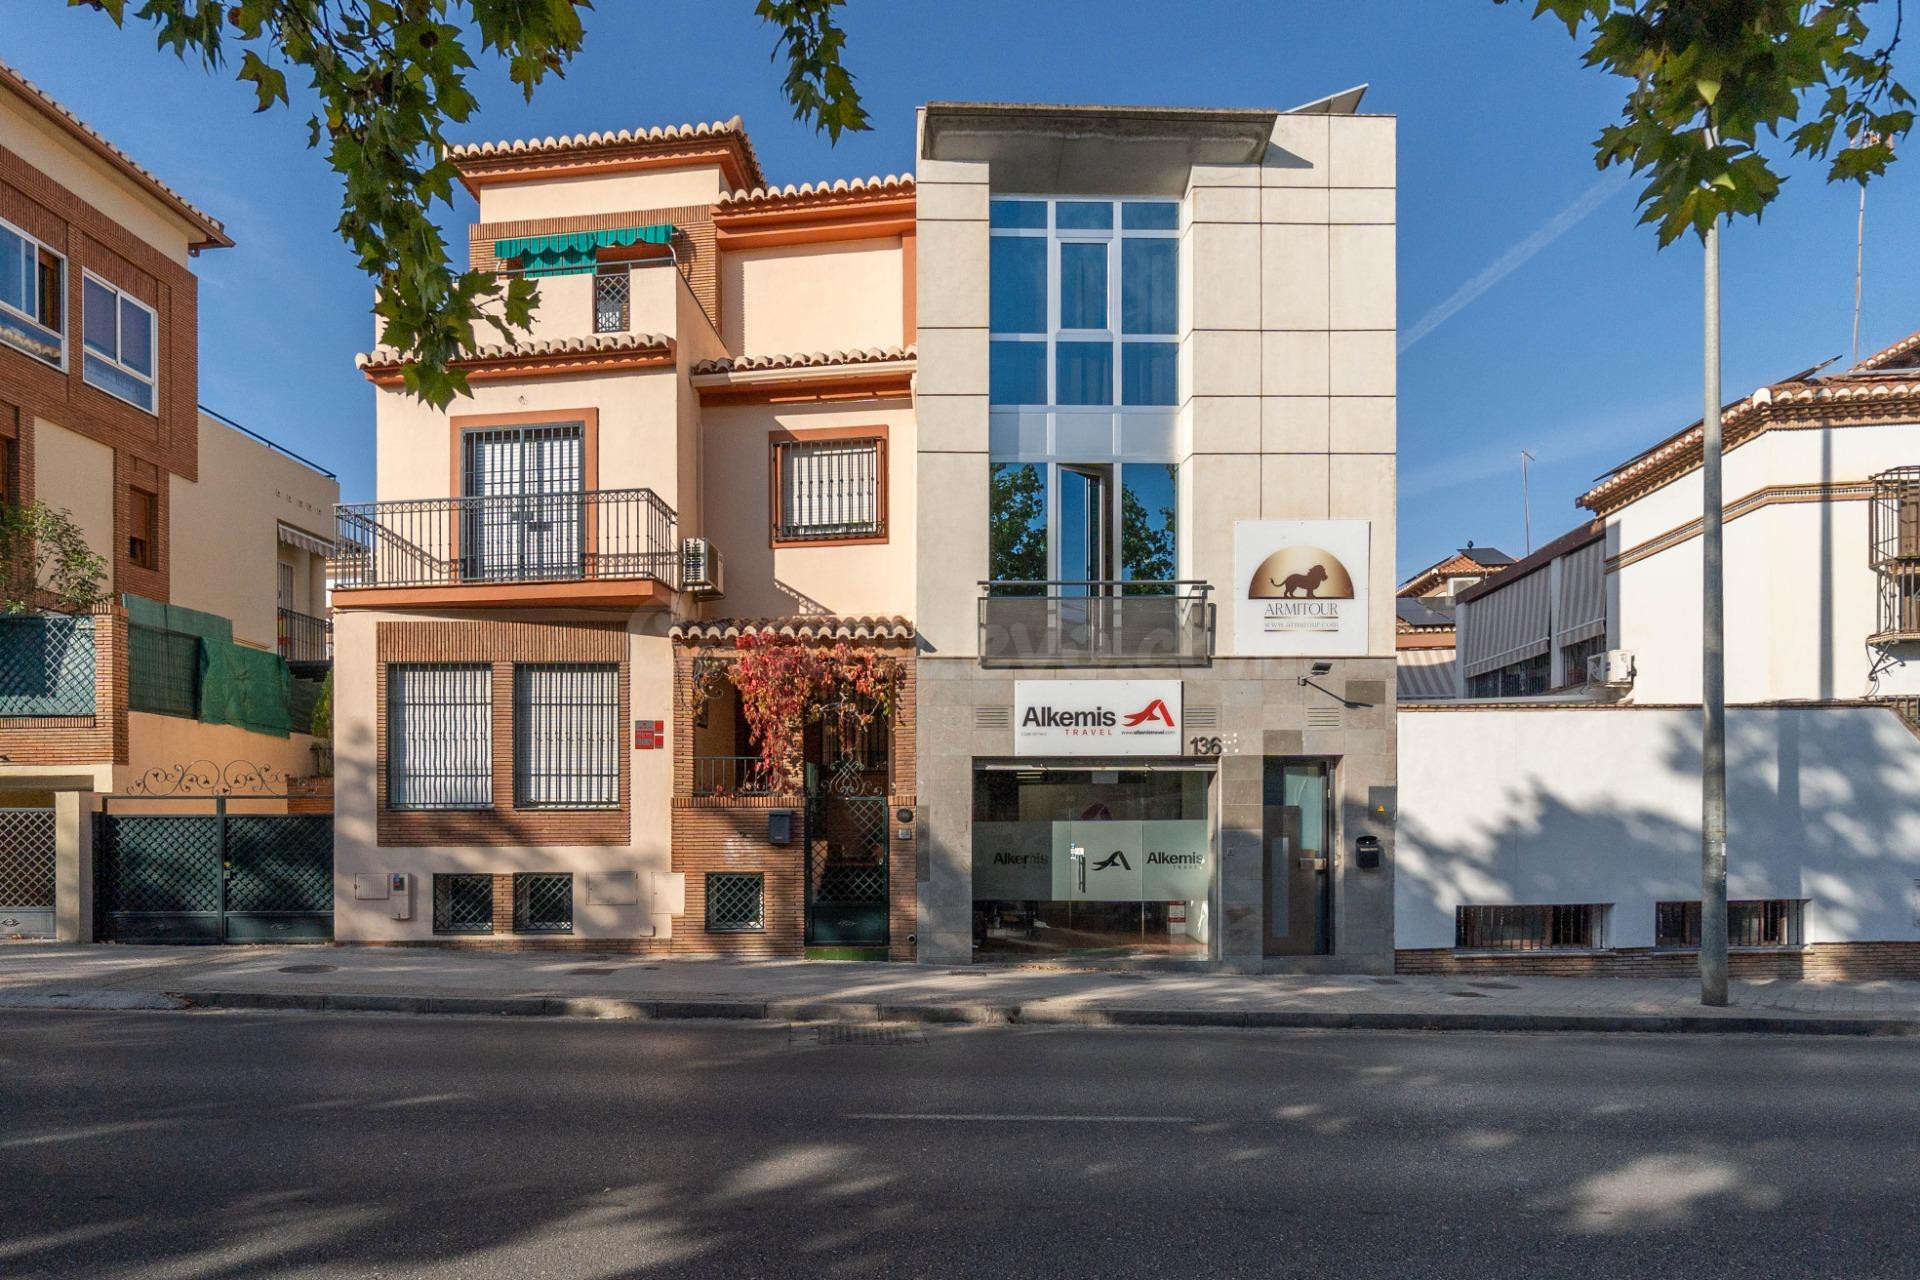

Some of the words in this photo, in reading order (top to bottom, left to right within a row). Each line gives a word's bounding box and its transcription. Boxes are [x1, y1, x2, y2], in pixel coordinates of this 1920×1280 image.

[1264, 602, 1338, 616] ARMITOUR
[1022, 706, 1116, 727] Alkemis
[1190, 736, 1222, 755] 136
[993, 852, 1049, 864] Alkemis
[1147, 852, 1204, 864] Alkemis
